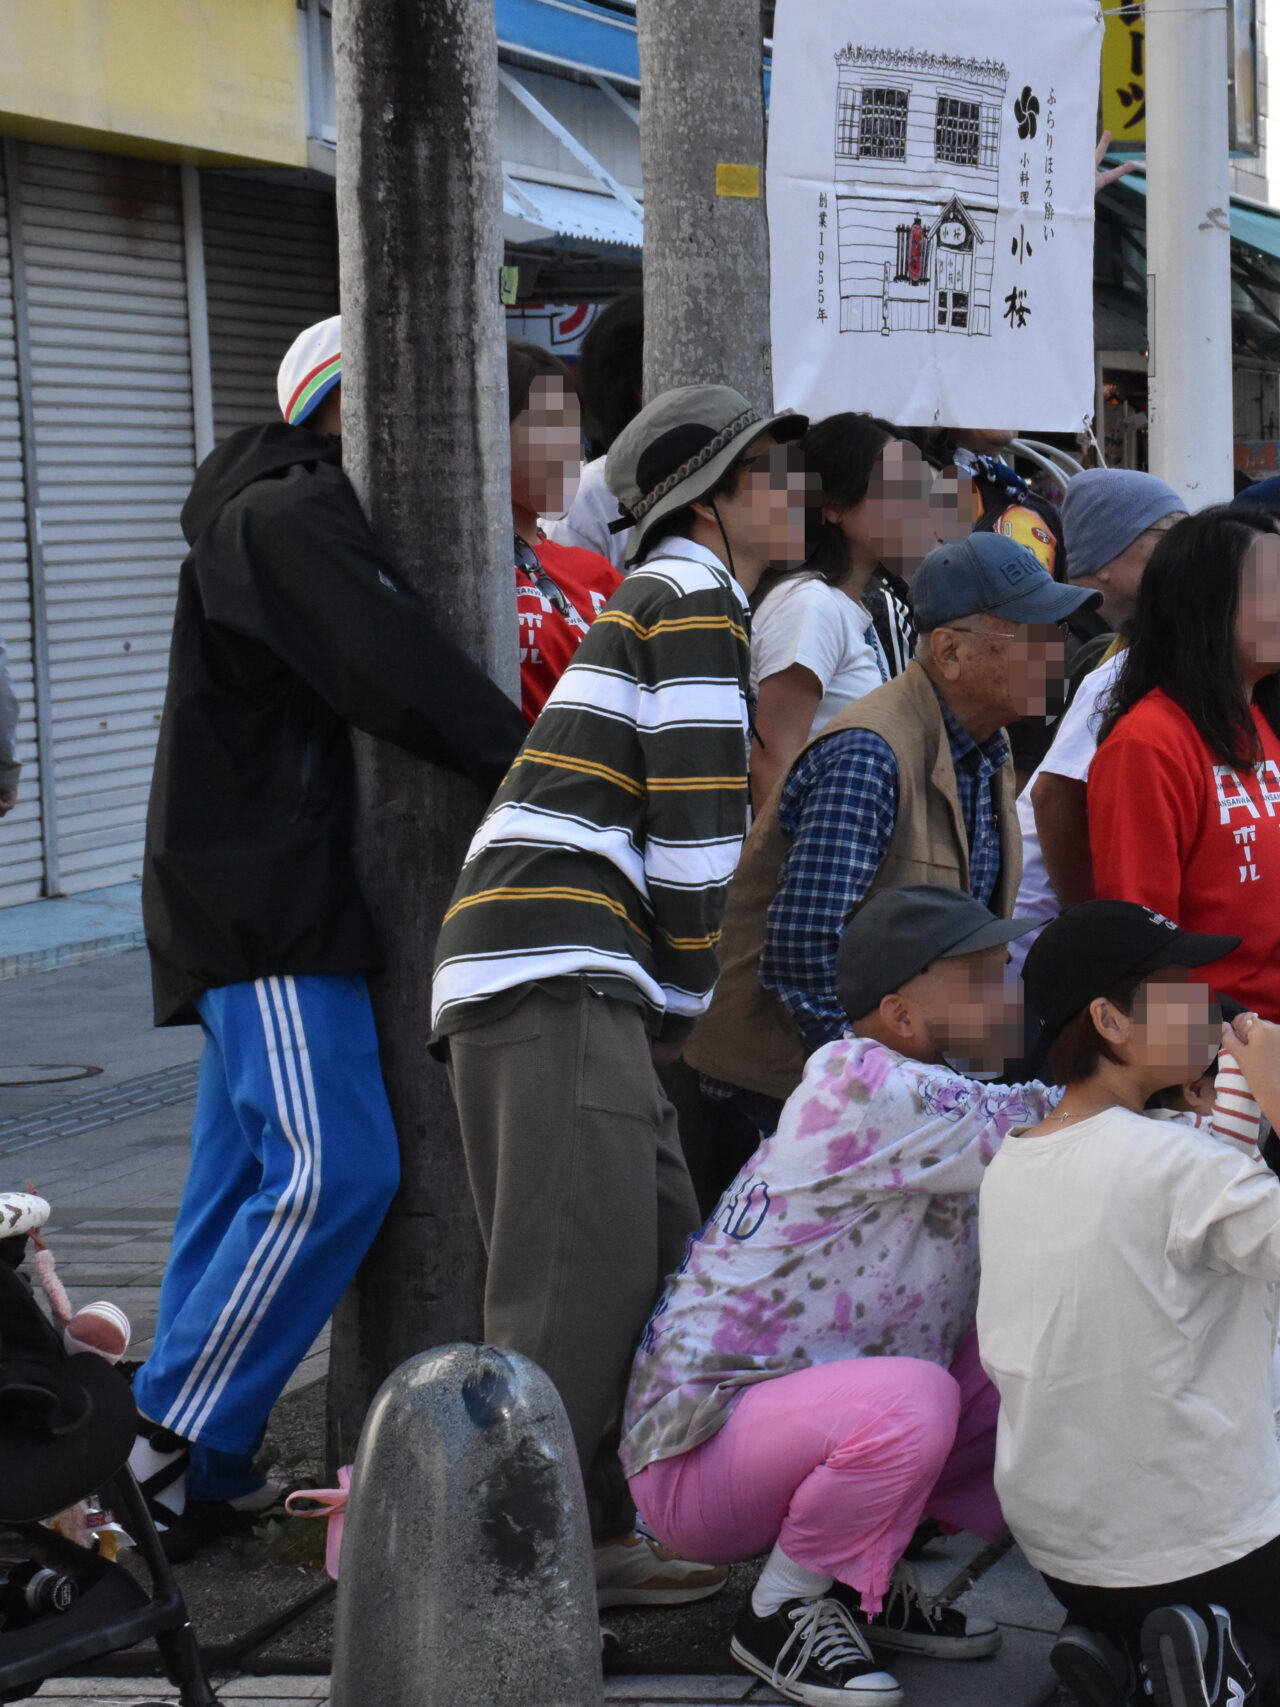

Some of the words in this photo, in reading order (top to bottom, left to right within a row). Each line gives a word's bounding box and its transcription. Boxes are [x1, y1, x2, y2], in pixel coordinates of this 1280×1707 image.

[1019, 152, 1030, 205] 小料理
[1043, 88, 1057, 241] ふらりほろ酔い
[816, 191, 828, 325] 創業1955年
[1003, 223, 1033, 329] 小桜
